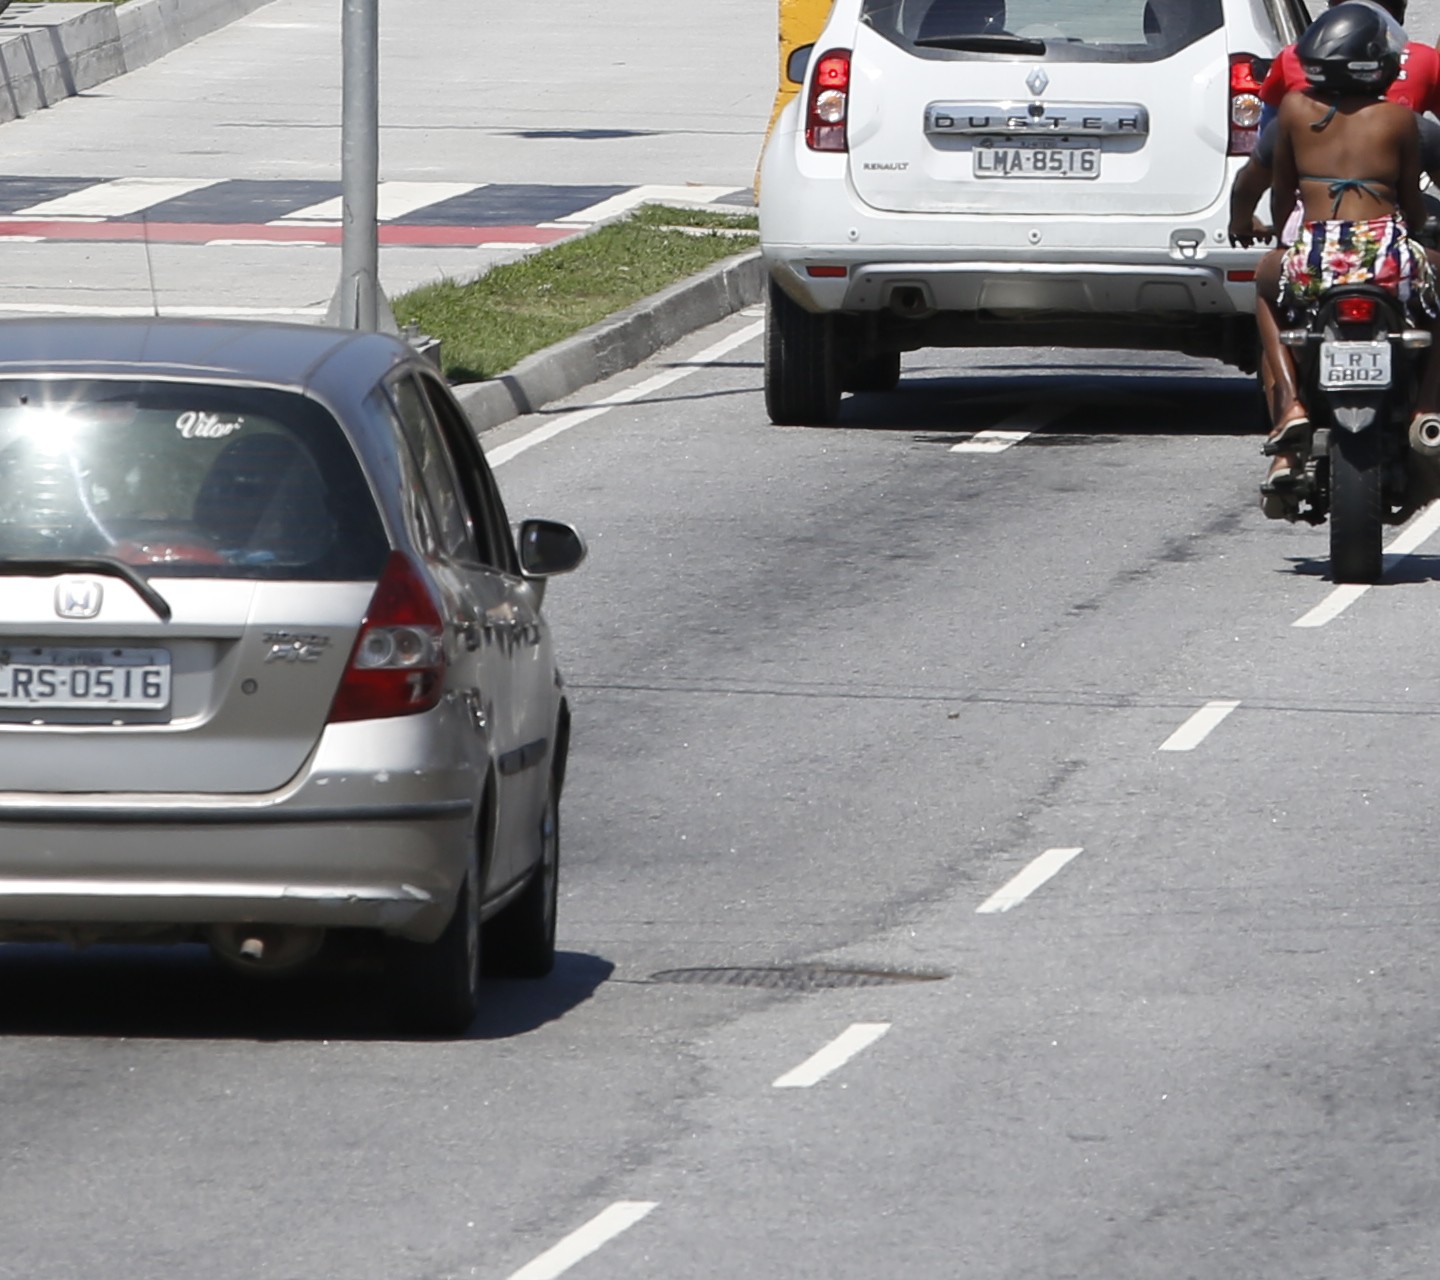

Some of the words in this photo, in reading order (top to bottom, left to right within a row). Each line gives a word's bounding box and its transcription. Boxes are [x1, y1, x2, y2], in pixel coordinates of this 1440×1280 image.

[934, 116, 1137, 130] DUSTER
[862, 162, 910, 171] RENAULT
[1330, 354, 1382, 368] LRT
[1327, 369, 1384, 383] 6802
